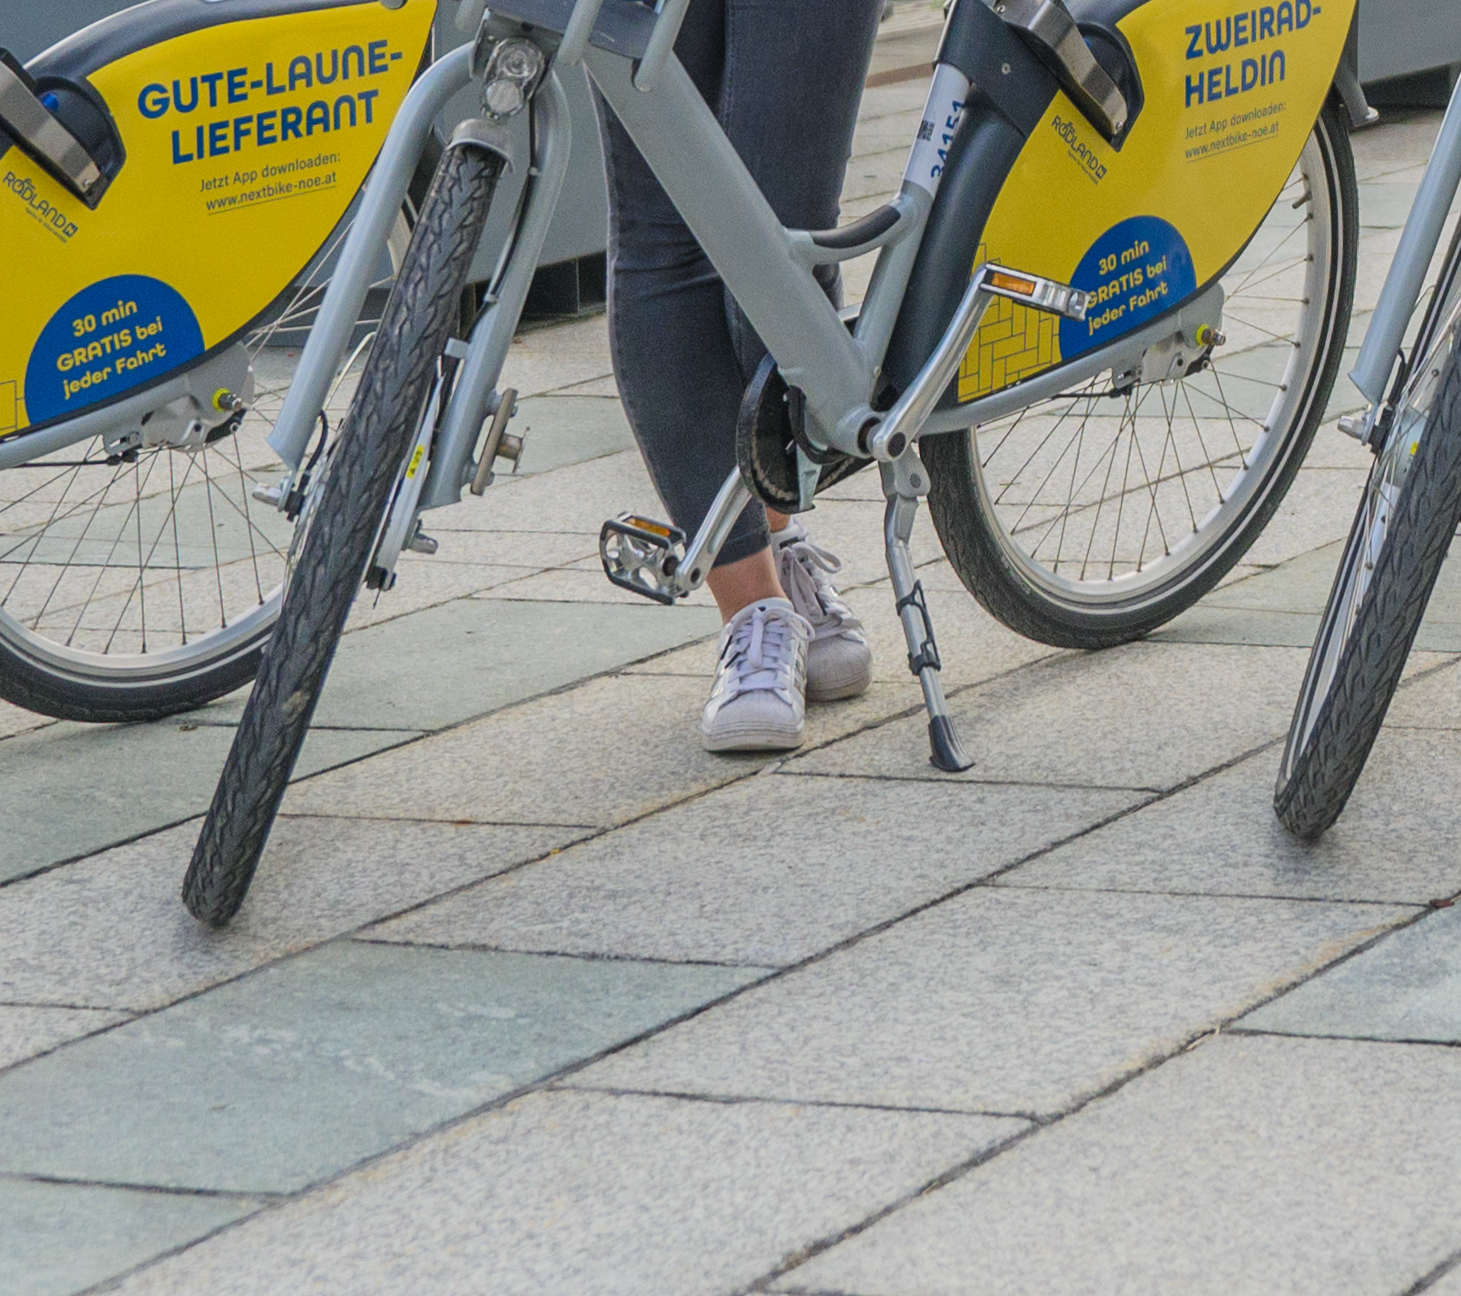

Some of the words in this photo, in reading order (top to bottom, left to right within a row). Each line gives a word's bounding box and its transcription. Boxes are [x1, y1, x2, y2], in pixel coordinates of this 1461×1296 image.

[137, 39, 403, 119] GUTE-LAUNE-
[1185, 49, 1286, 108] HELDIN
[171, 88, 379, 165] LIEFERANT
[1185, 122, 1207, 140] Jetzt
[1209, 119, 1227, 134] App
[1230, 101, 1286, 126] downloaden:
[1185, 122, 1279, 159] www.nextbike-noe.at
[200, 172, 229, 192] Jetzt
[232, 167, 258, 186] App
[261, 152, 341, 179] downloaden:
[205, 171, 337, 211] www.nextbike-noe.at
[1087, 268, 1143, 309] GRATIS
[1146, 255, 1167, 278] bei
[1098, 254, 1117, 276] 30
[1121, 240, 1149, 265] min
[72, 314, 96, 337] 30
[101, 300, 138, 326] min
[1088, 304, 1126, 336] jeder
[1129, 281, 1169, 312] Fahrt
[56, 329, 132, 371] GRATIS
[135, 316, 163, 339] bei
[63, 367, 112, 400] jeder
[115, 343, 167, 374] Fahrt
